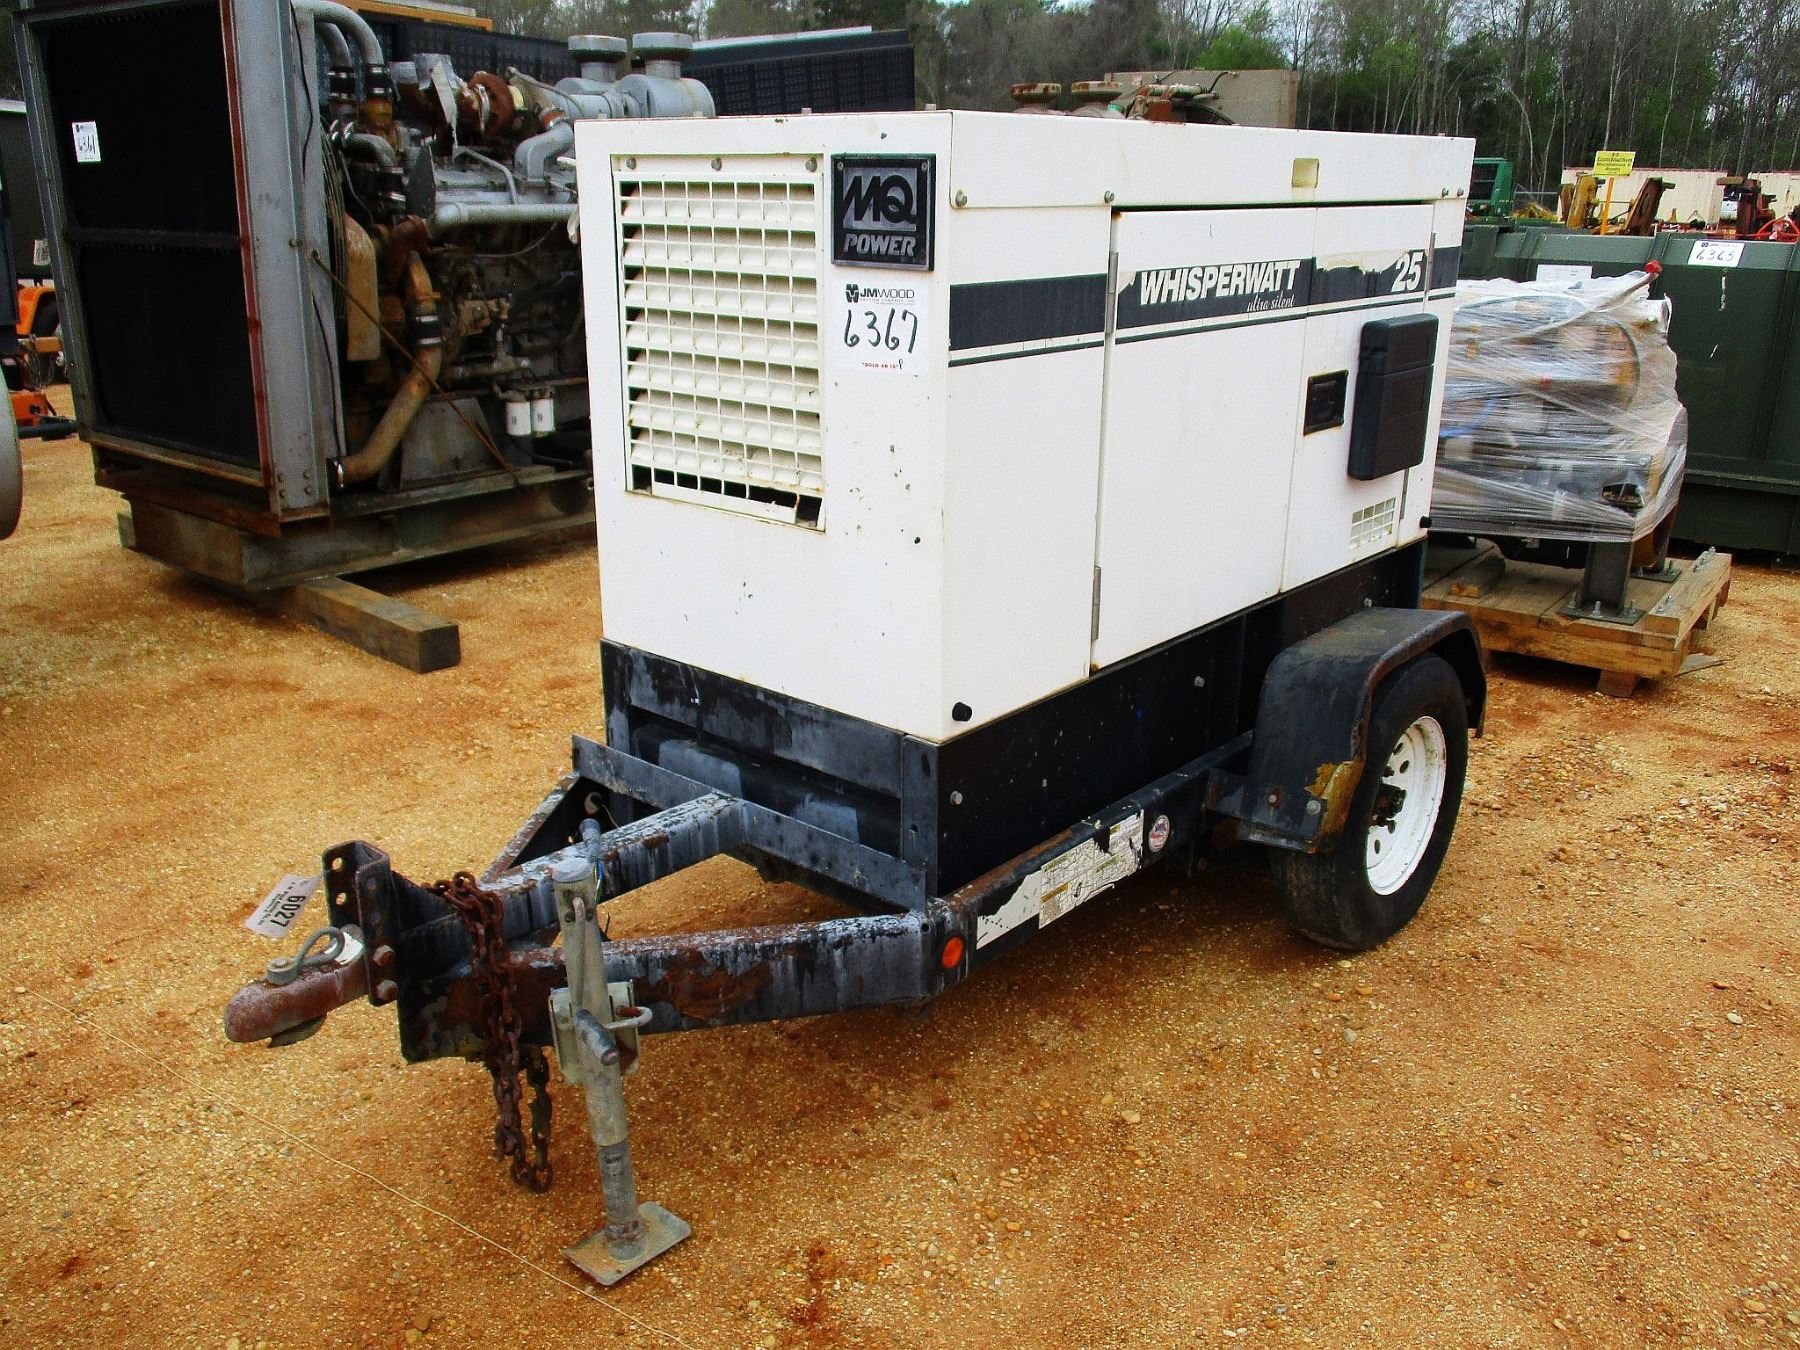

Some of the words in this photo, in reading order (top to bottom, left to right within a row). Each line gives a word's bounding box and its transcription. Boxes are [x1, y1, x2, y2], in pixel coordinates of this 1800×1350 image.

[842, 174, 917, 224] MQ
[843, 233, 916, 256] POWER
[1140, 260, 1300, 305] WHISPERWATT
[1391, 252, 1424, 292] 25
[1247, 293, 1269, 312] ultra
[1270, 291, 1295, 309] silent
[844, 308, 917, 353] 6367
[270, 895, 306, 927] 6027
